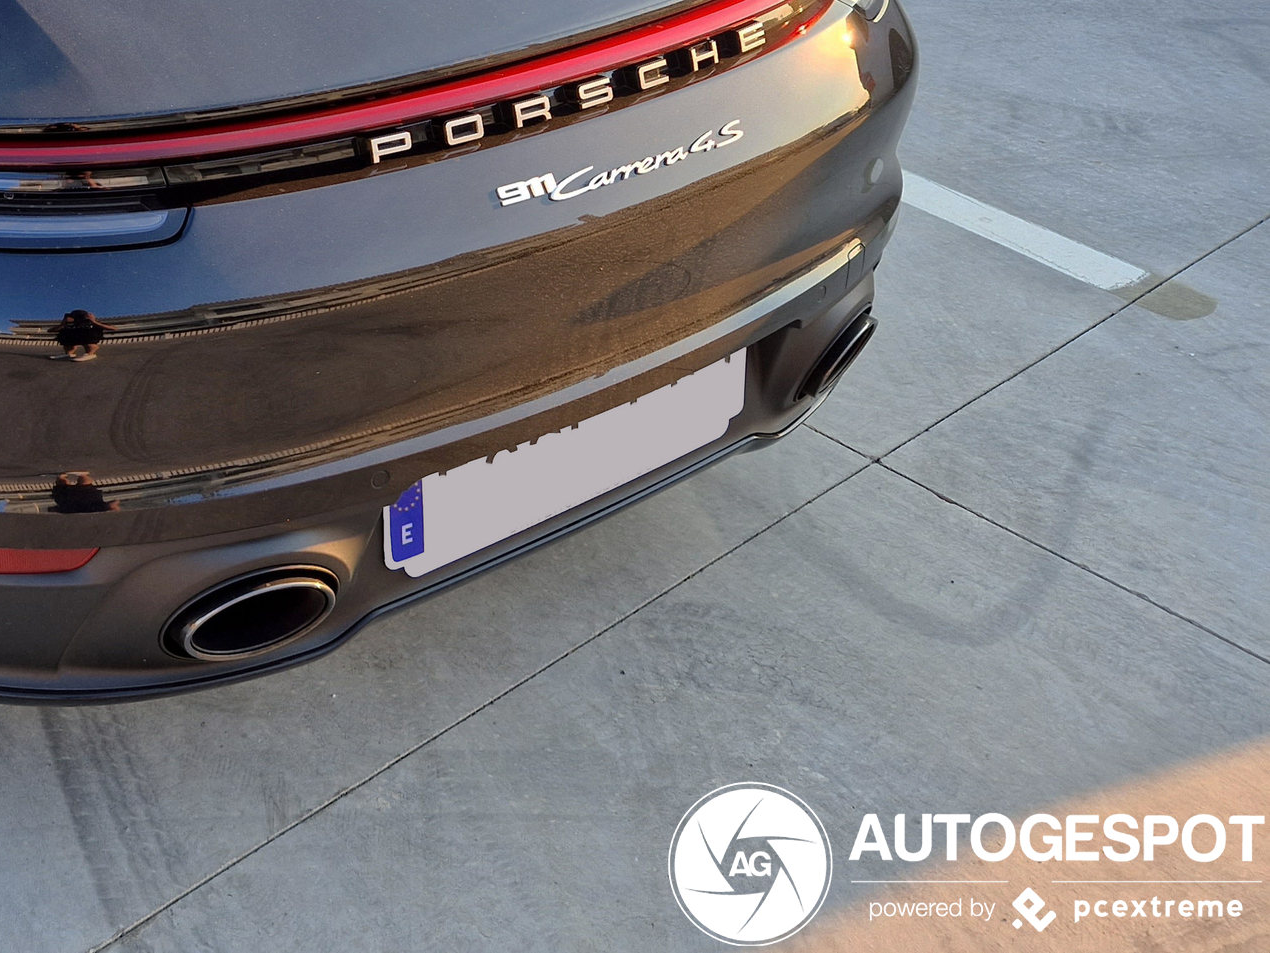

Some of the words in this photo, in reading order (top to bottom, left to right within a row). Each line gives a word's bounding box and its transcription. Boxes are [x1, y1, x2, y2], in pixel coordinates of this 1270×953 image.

[371, 20, 767, 165] PORSCHE
[496, 172, 558, 207] 911
[401, 523, 414, 545] E
